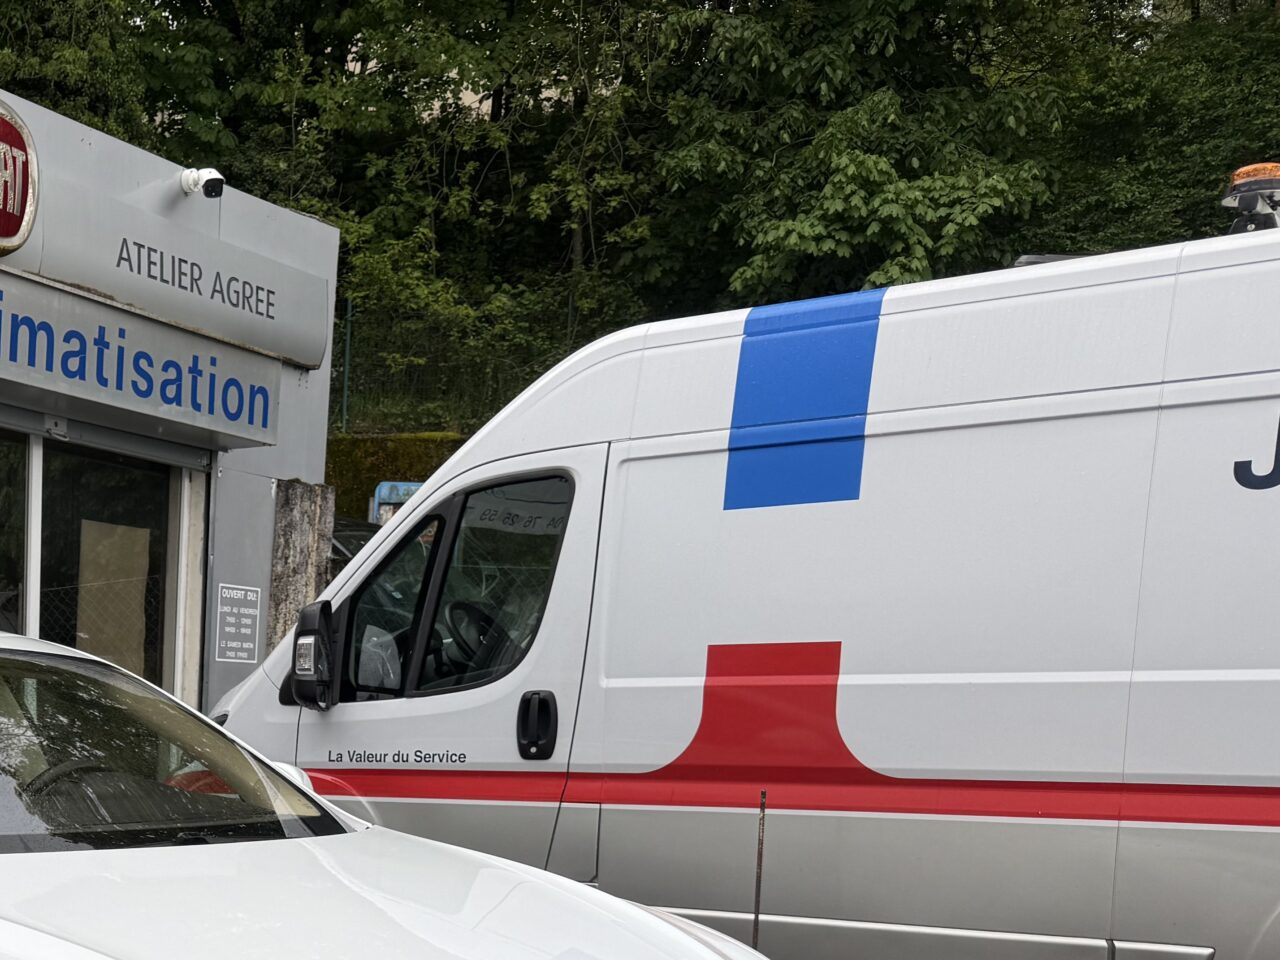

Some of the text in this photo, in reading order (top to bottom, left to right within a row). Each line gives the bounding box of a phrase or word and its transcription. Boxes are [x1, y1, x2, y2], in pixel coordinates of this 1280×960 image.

[115, 237, 276, 320] ATELIER AGREE
[222, 589, 246, 599] OUVERT
[328, 750, 467, 763] La Valeur du Service
